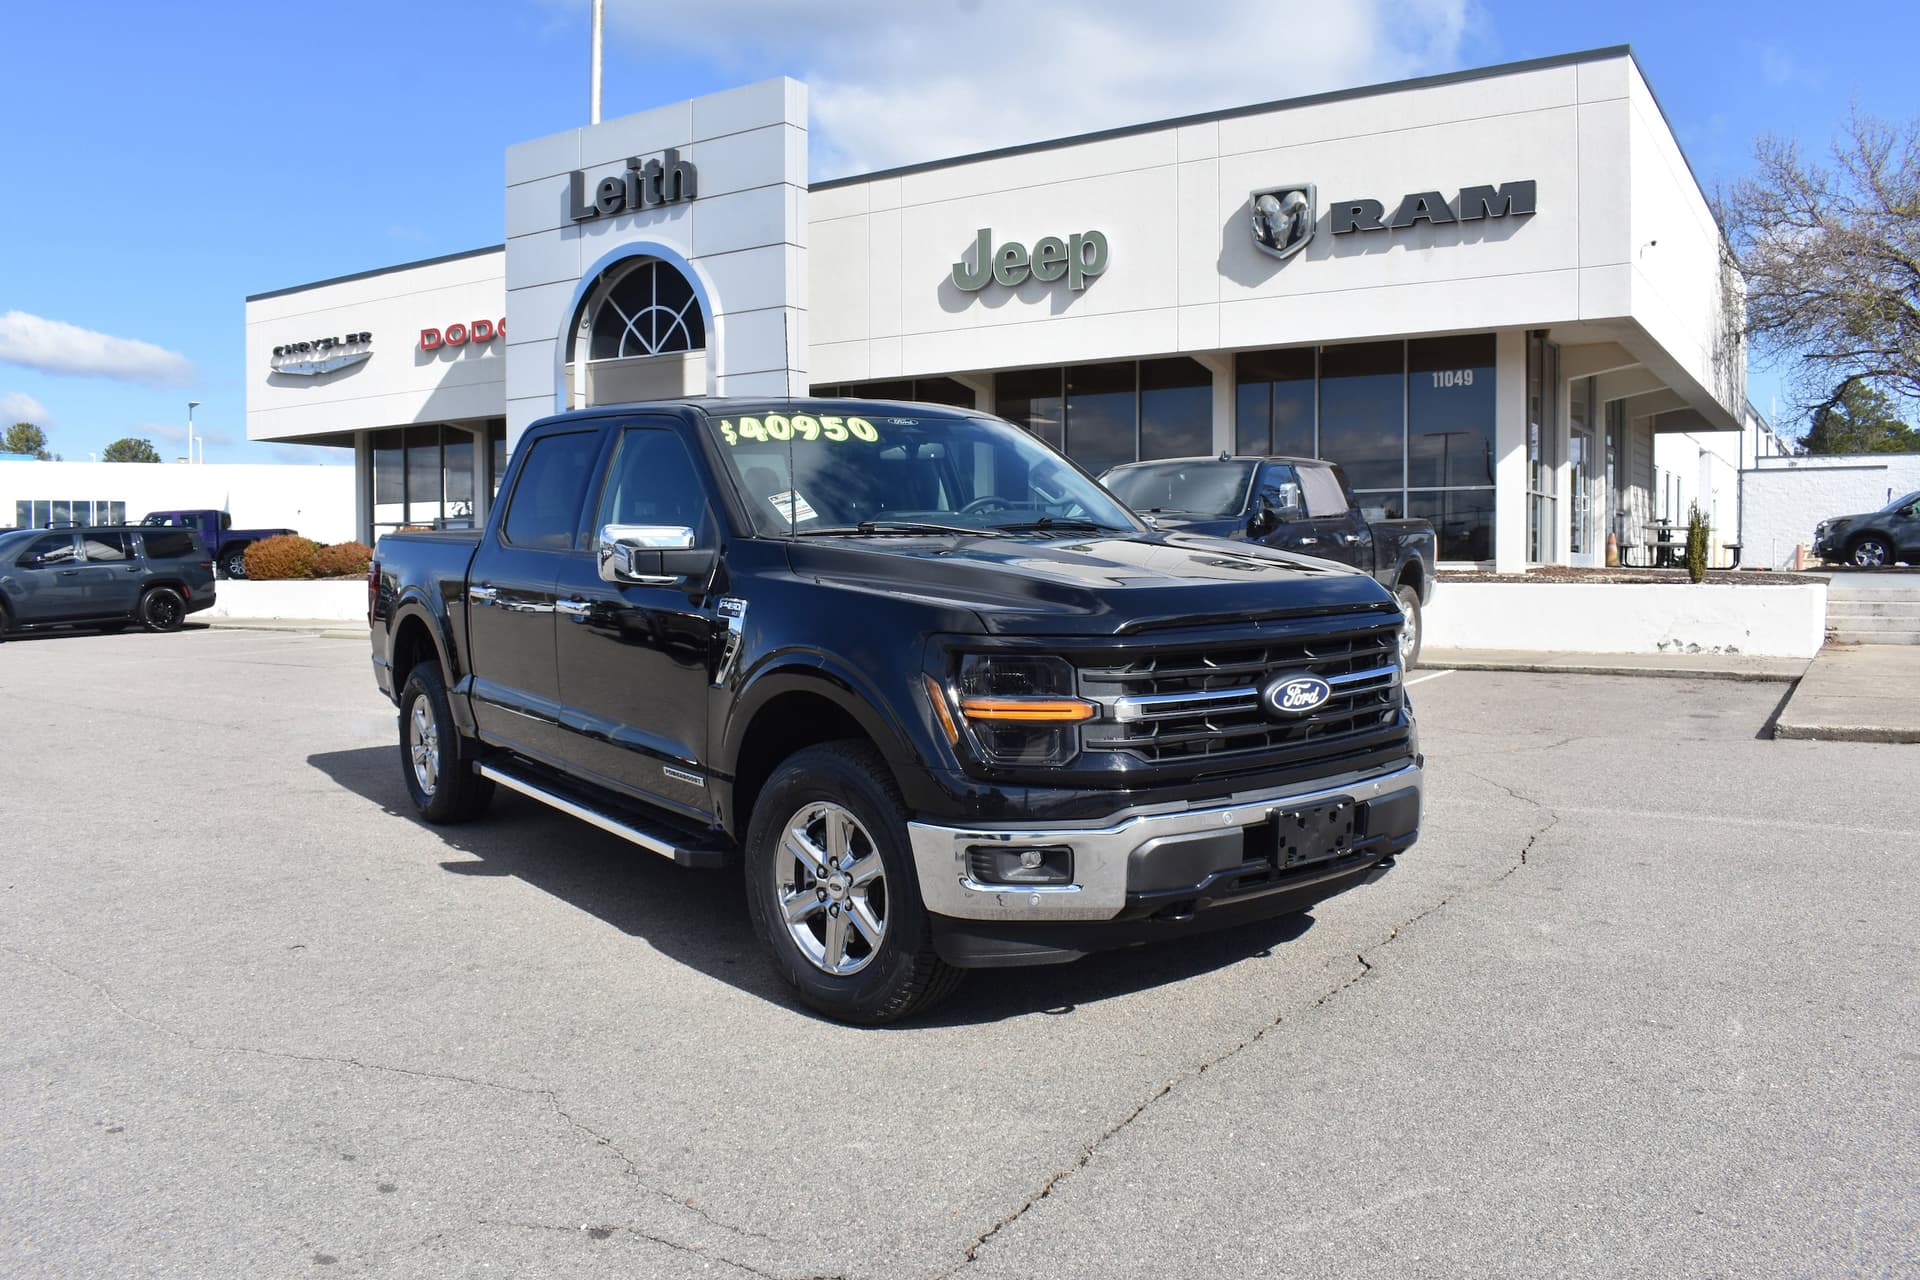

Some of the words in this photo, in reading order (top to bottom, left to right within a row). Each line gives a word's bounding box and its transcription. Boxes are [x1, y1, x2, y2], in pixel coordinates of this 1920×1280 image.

[569, 148, 698, 221] Leith
[1330, 179, 1537, 234] RAM
[951, 227, 1109, 291] Jeep
[273, 331, 373, 357] CHRYSLER
[1432, 369, 1473, 388] 11049
[720, 414, 879, 446] $40950
[1283, 683, 1320, 707] Ford
